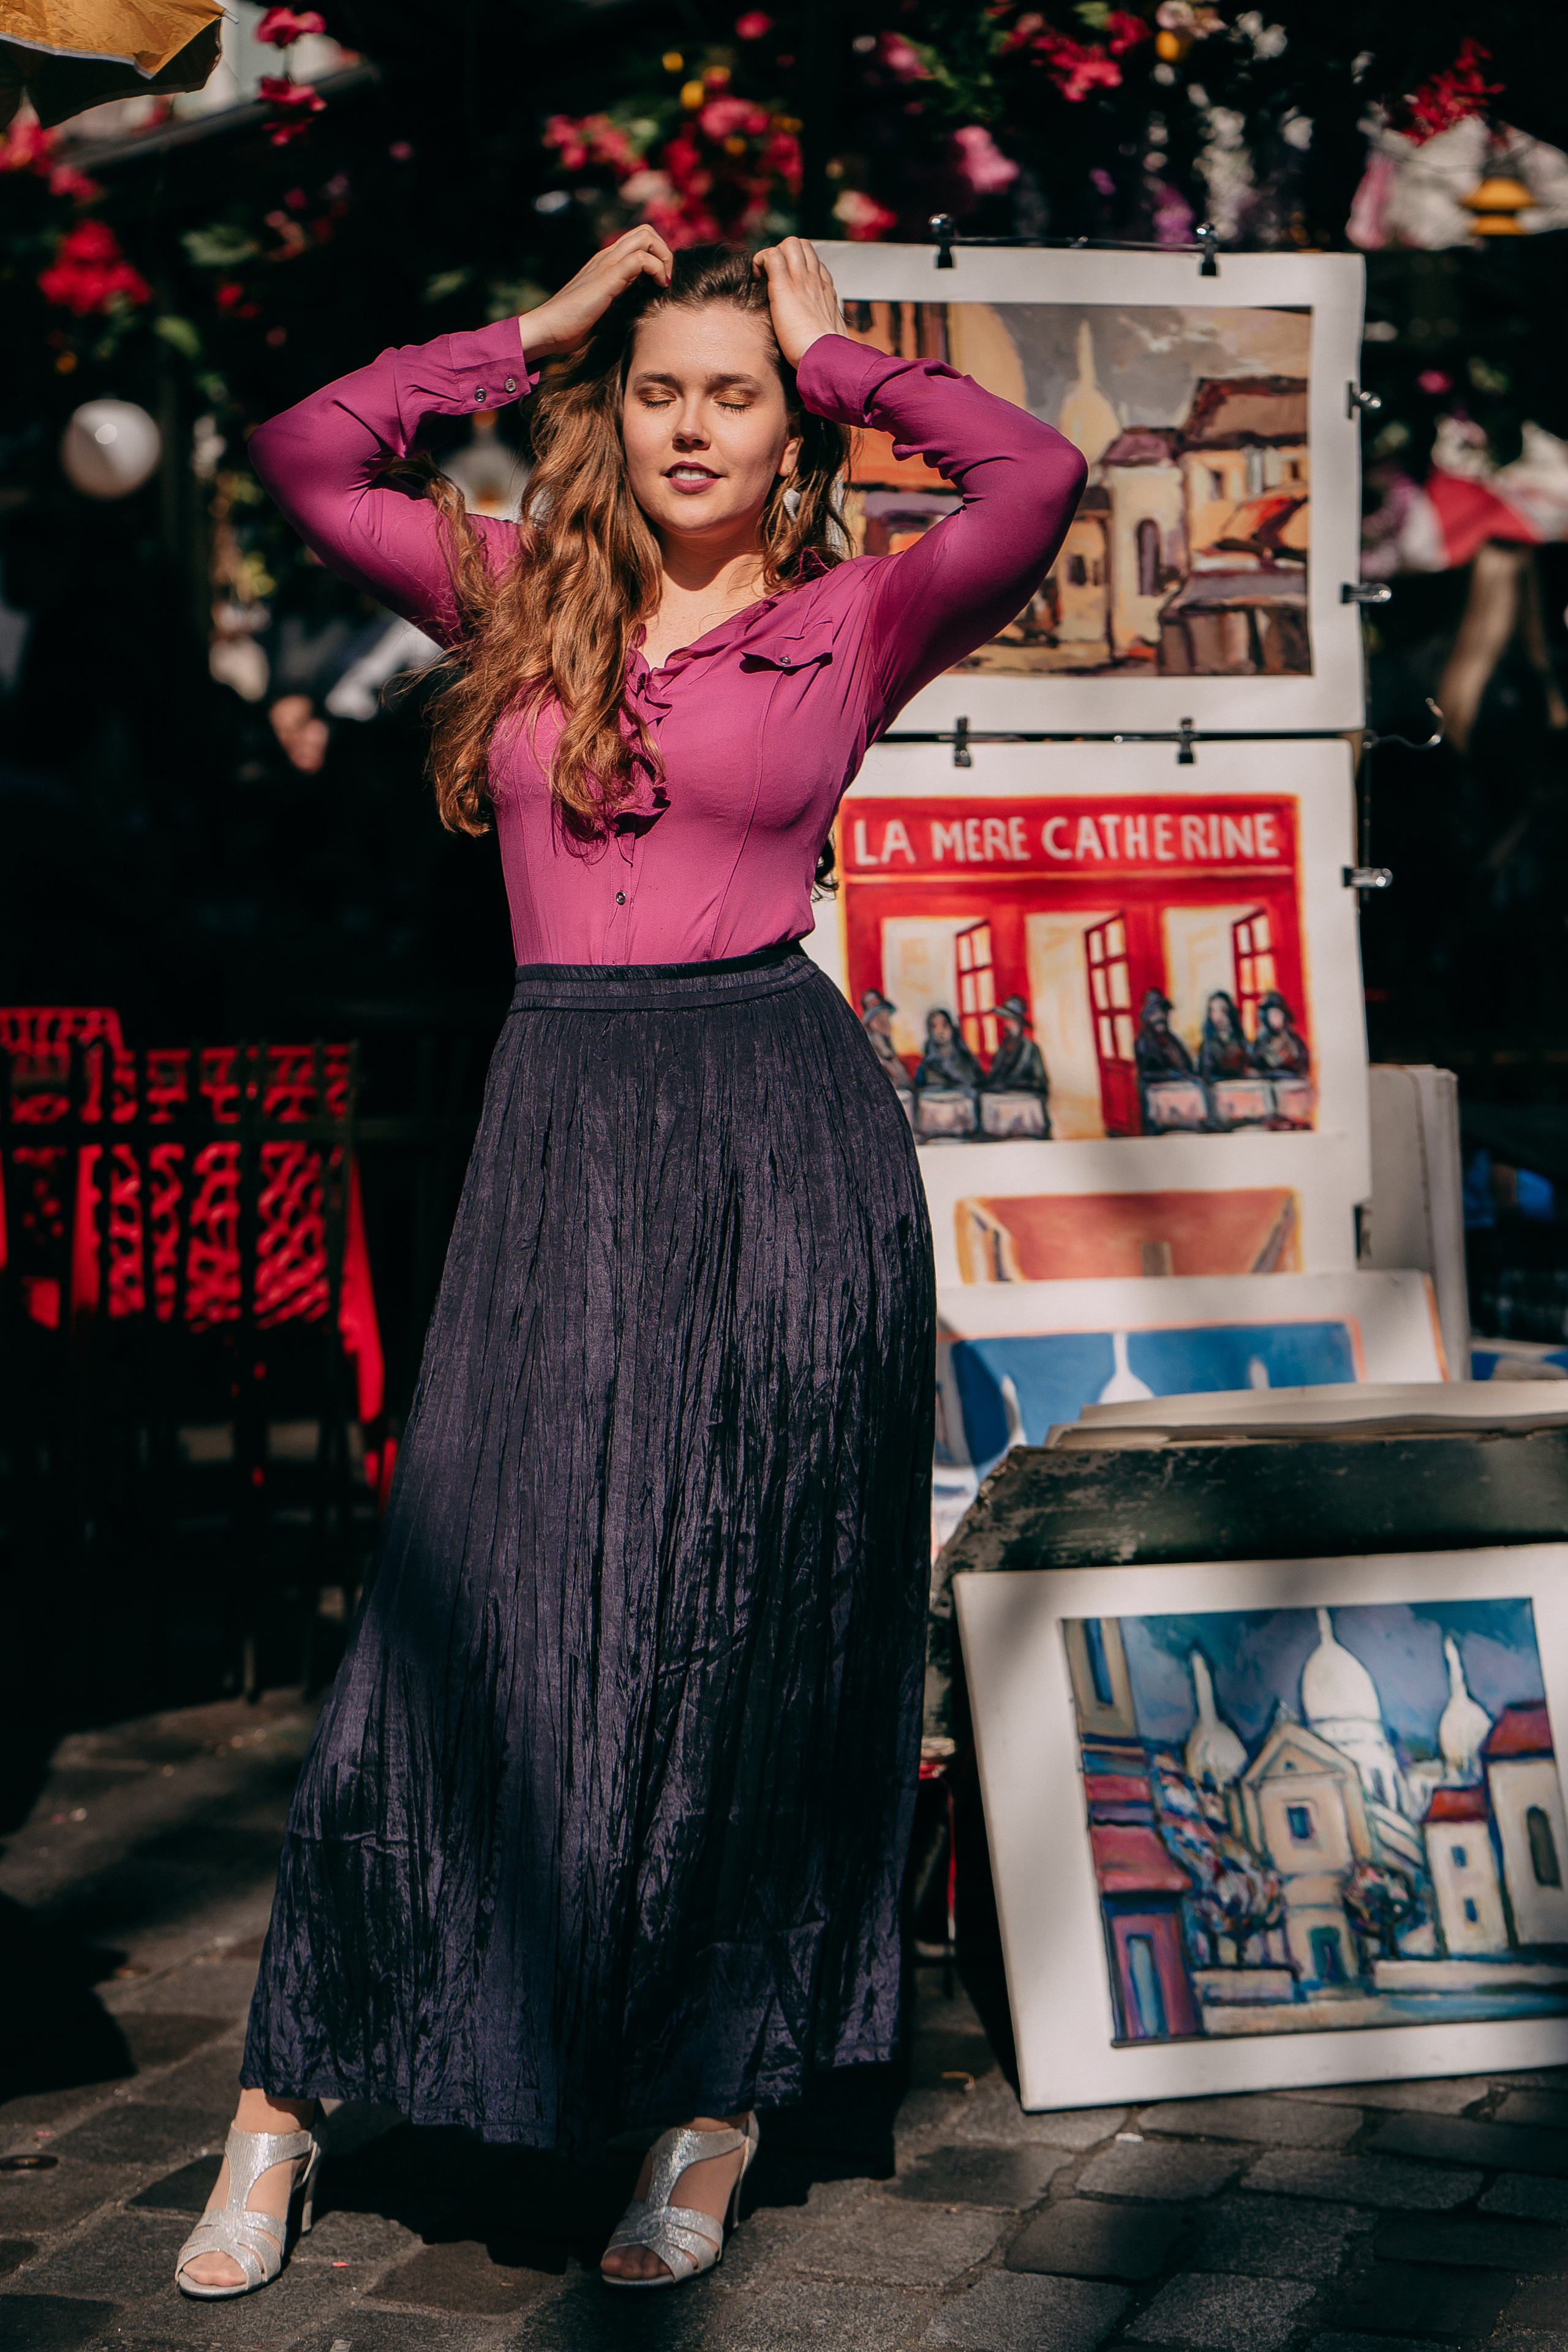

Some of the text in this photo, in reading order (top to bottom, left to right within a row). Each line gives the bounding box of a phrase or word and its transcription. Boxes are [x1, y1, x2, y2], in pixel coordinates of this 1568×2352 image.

[854, 813, 1280, 866] LA MERE CATHERINE
